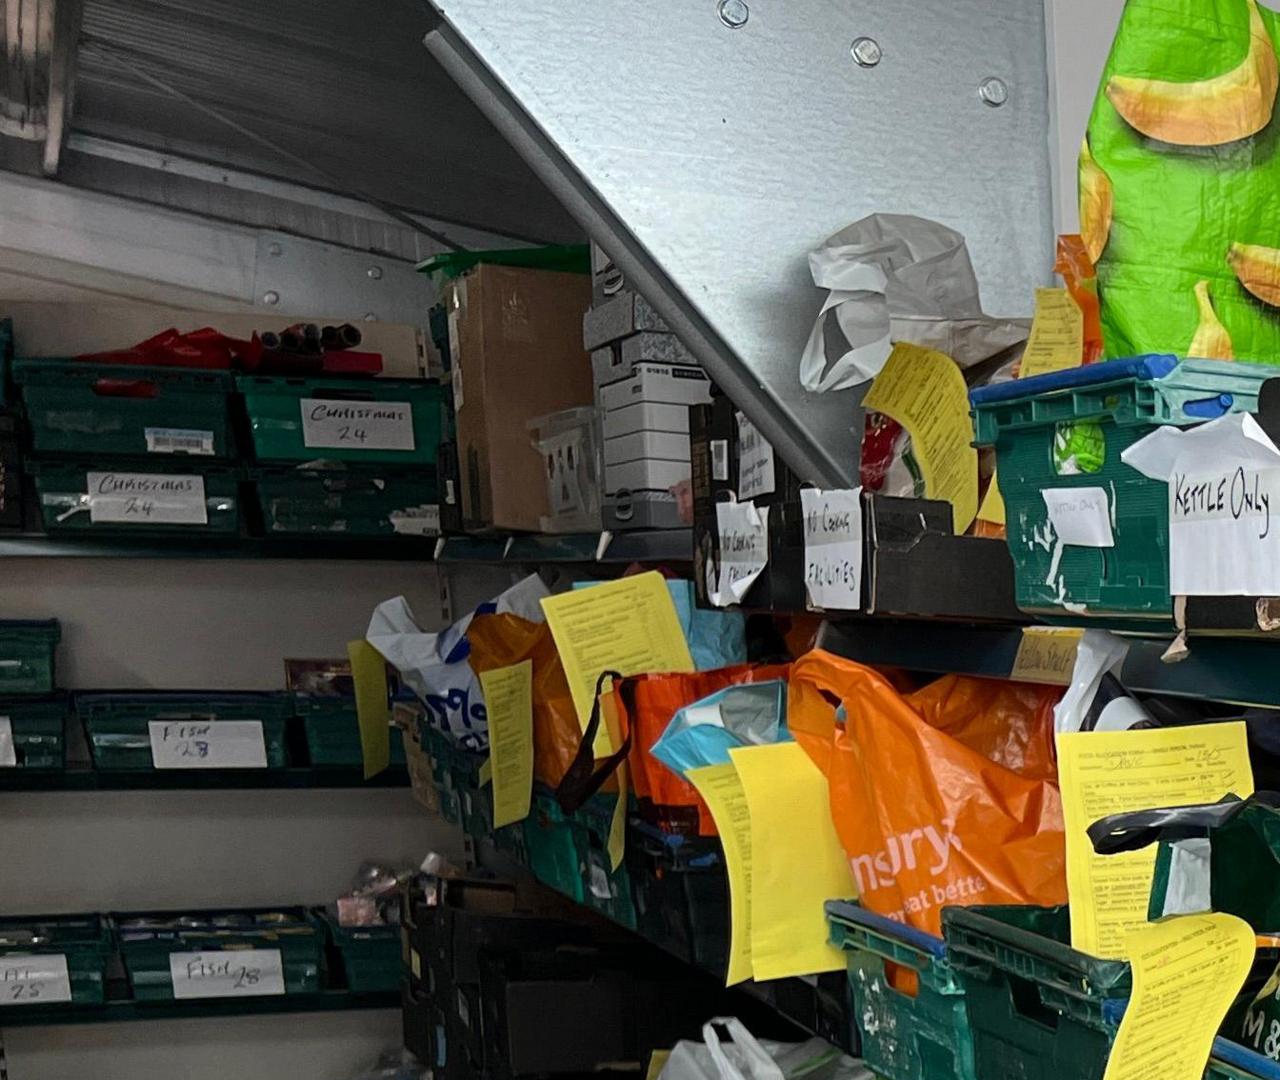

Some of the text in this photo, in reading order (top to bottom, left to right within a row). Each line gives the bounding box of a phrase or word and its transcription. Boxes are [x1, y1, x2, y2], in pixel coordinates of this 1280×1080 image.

[311, 405, 405, 421] CHRISTMAS
[337, 427, 367, 441] 24
[1174, 473, 1227, 516] KETTLE
